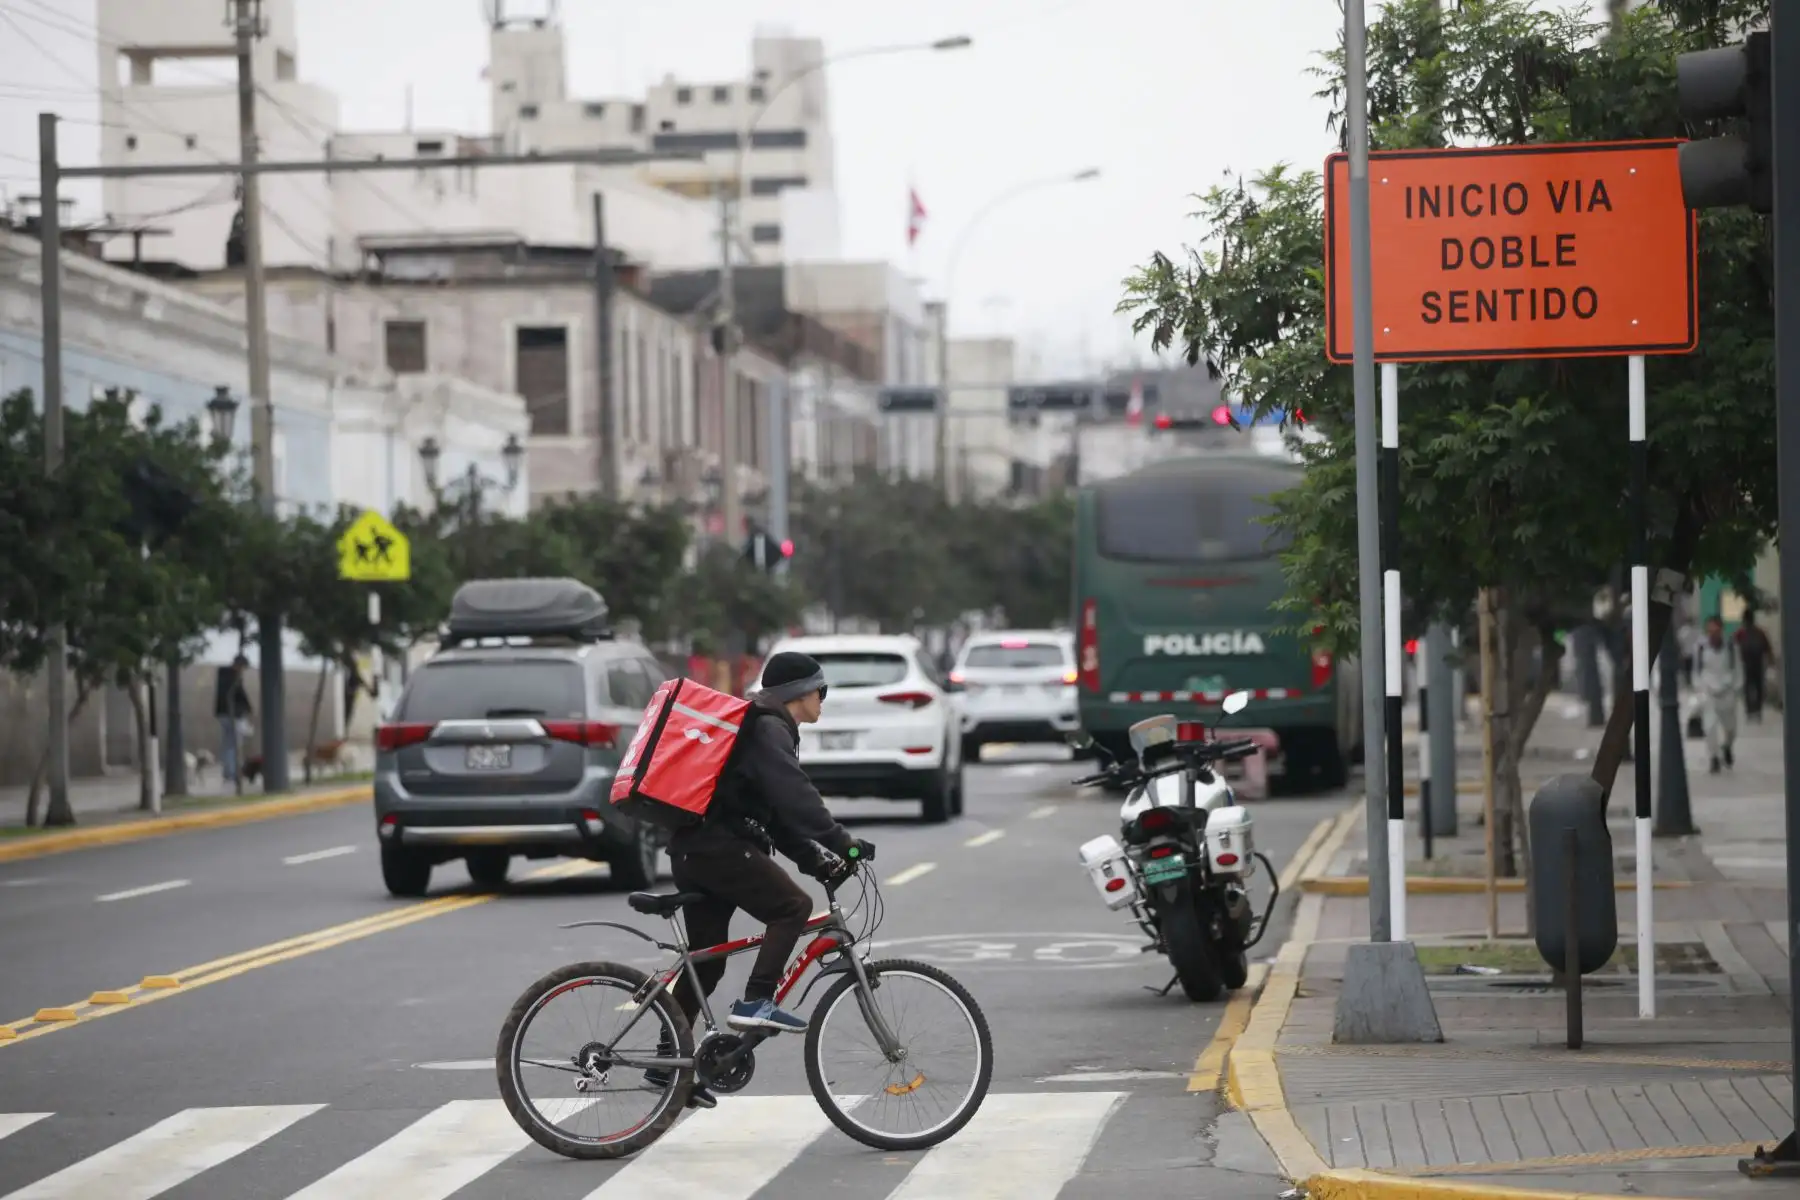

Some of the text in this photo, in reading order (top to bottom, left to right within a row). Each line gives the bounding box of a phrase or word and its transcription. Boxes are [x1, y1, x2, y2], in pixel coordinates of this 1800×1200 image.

[1405, 178, 1613, 219] INICIO VIA
[1441, 233, 1577, 271] DOBLE
[1420, 285, 1599, 324] SENTIDO
[1143, 629, 1265, 656] POLICÍA
